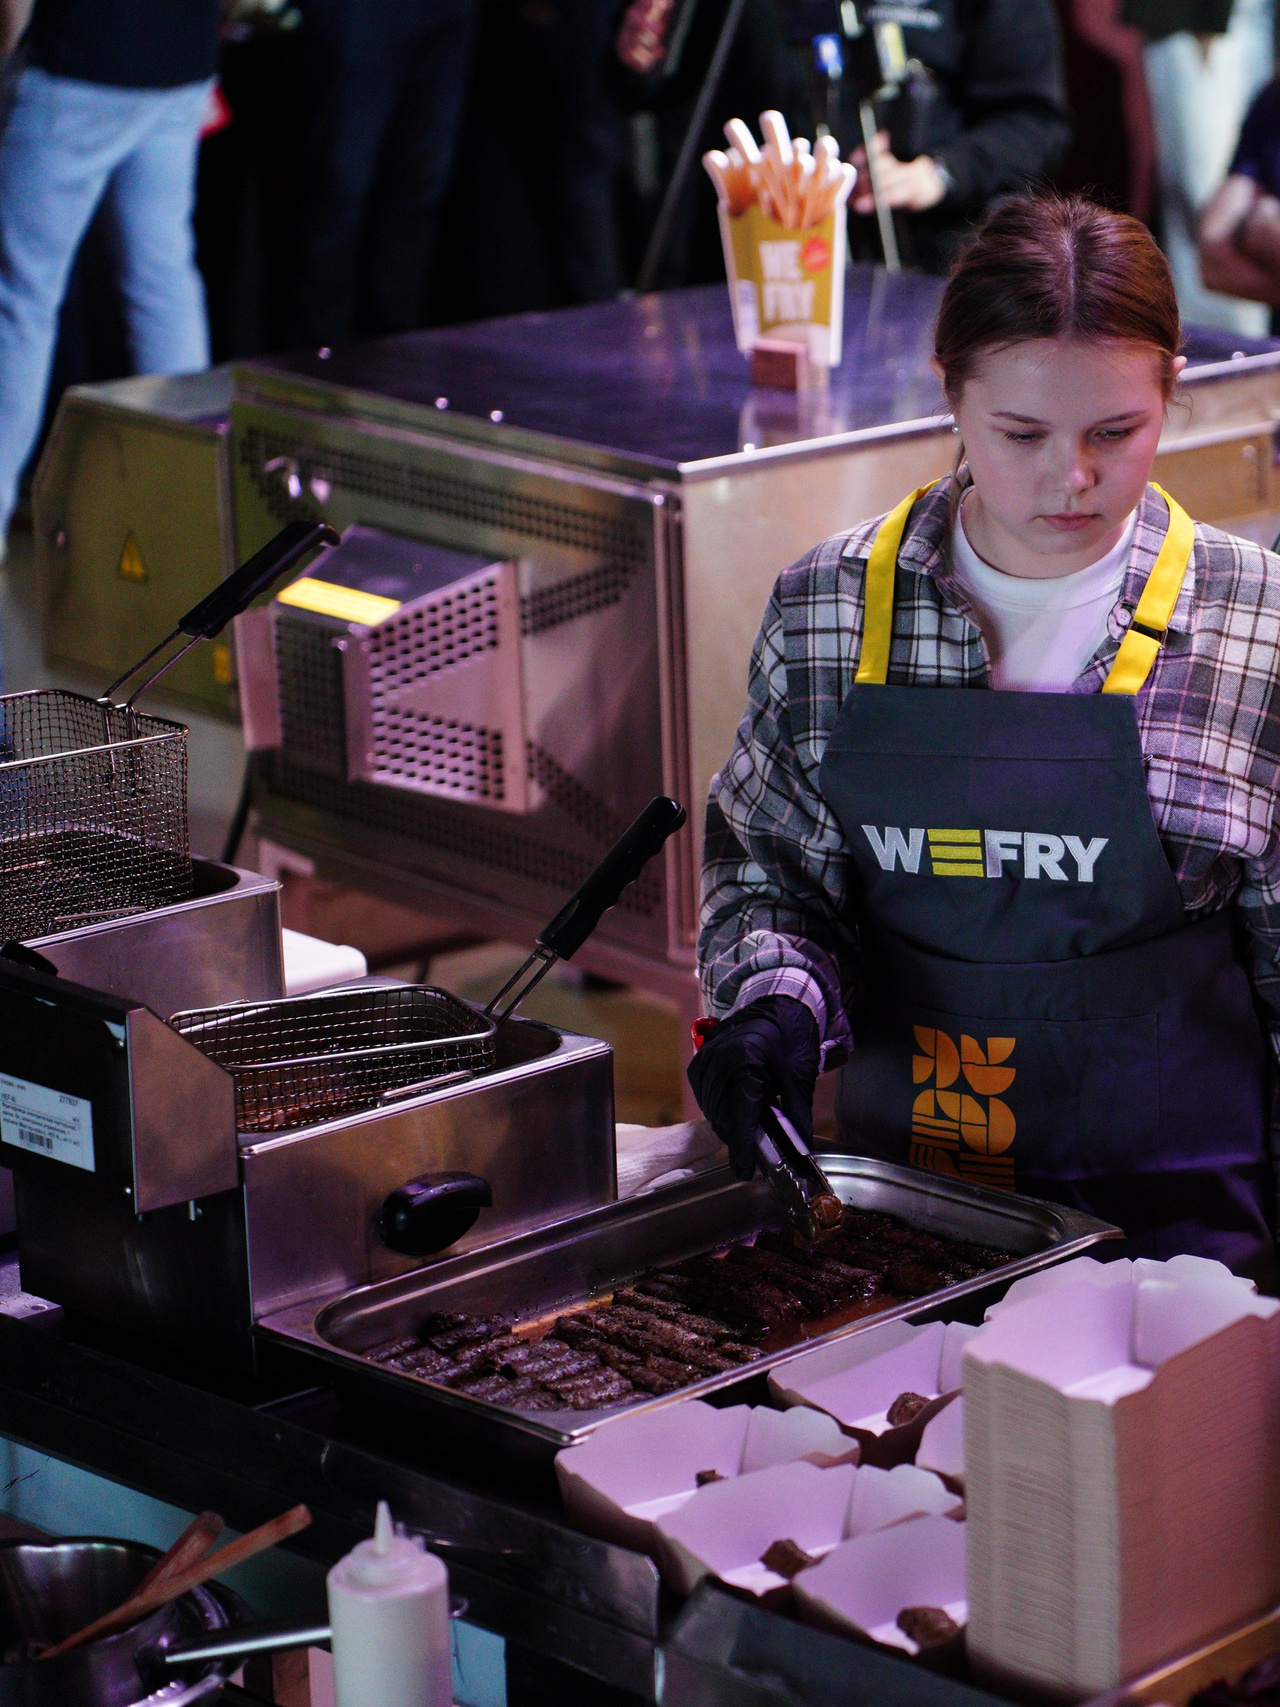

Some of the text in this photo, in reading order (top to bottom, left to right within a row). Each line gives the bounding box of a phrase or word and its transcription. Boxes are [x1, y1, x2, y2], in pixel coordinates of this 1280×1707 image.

[758, 240, 804, 281] WE
[762, 280, 816, 323] FRY
[861, 824, 1109, 883] WEFRY
